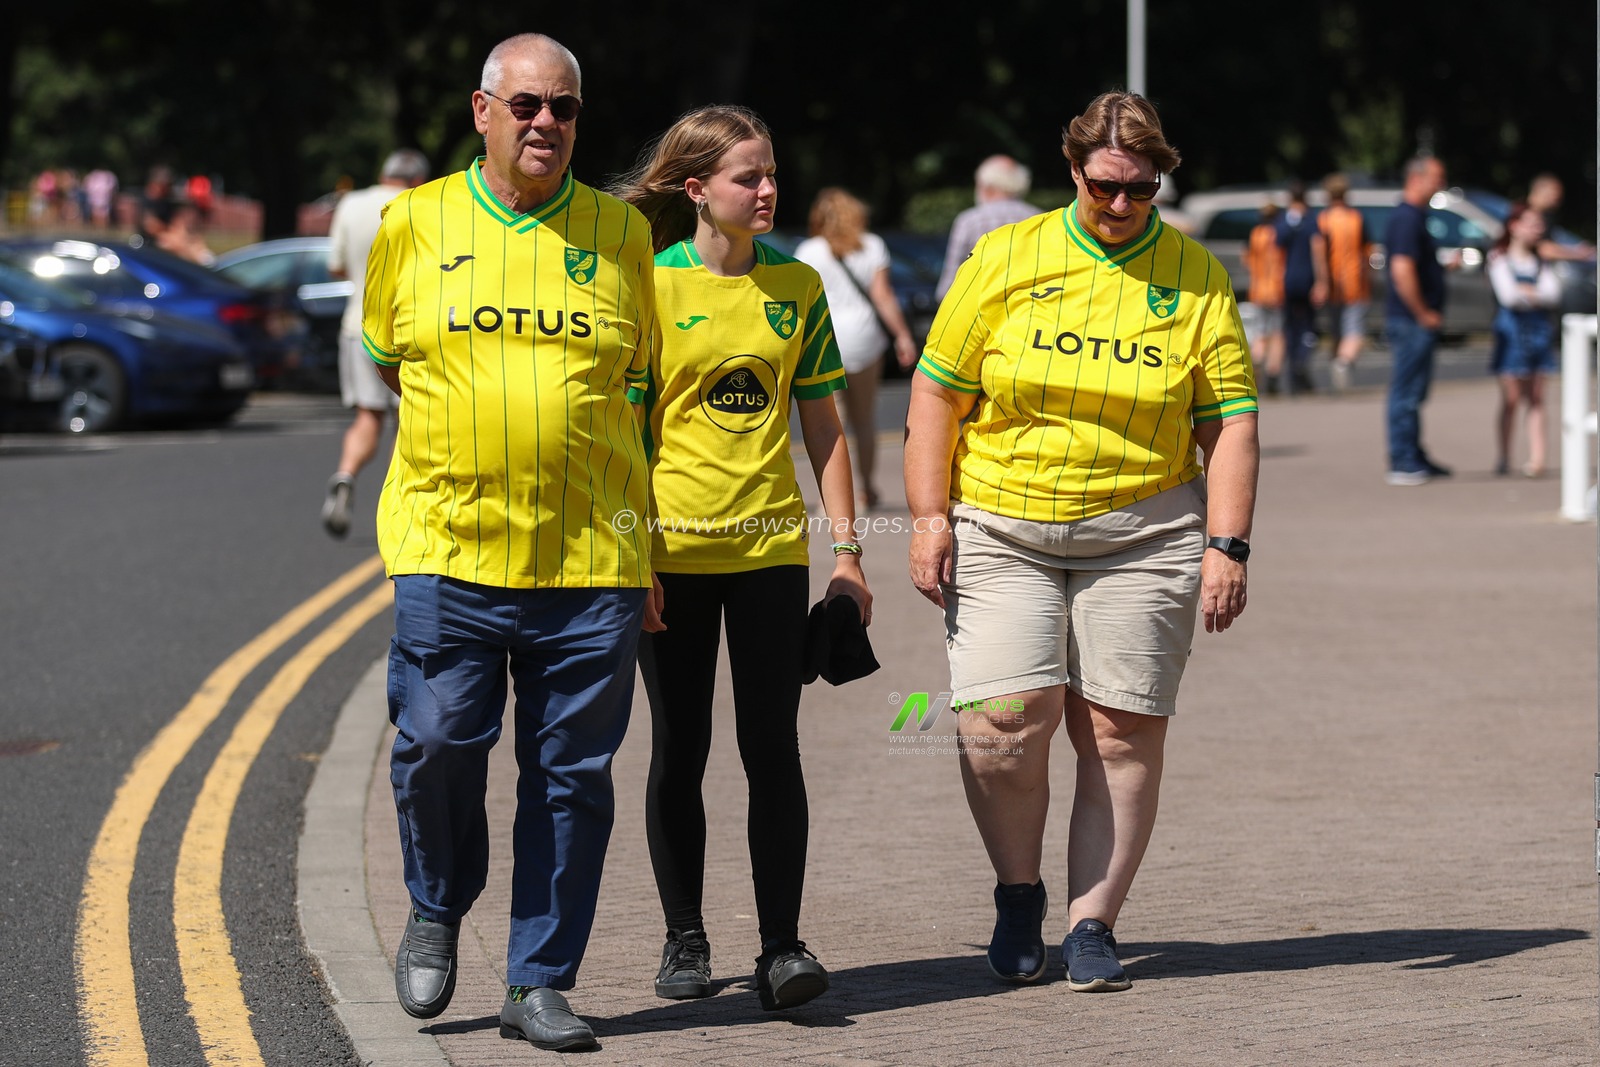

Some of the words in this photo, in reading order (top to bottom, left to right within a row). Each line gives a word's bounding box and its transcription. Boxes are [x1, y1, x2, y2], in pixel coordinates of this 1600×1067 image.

[448, 306, 592, 338] LOTUS
[1032, 329, 1163, 368] LOTUS
[712, 393, 765, 406] LOTUS
